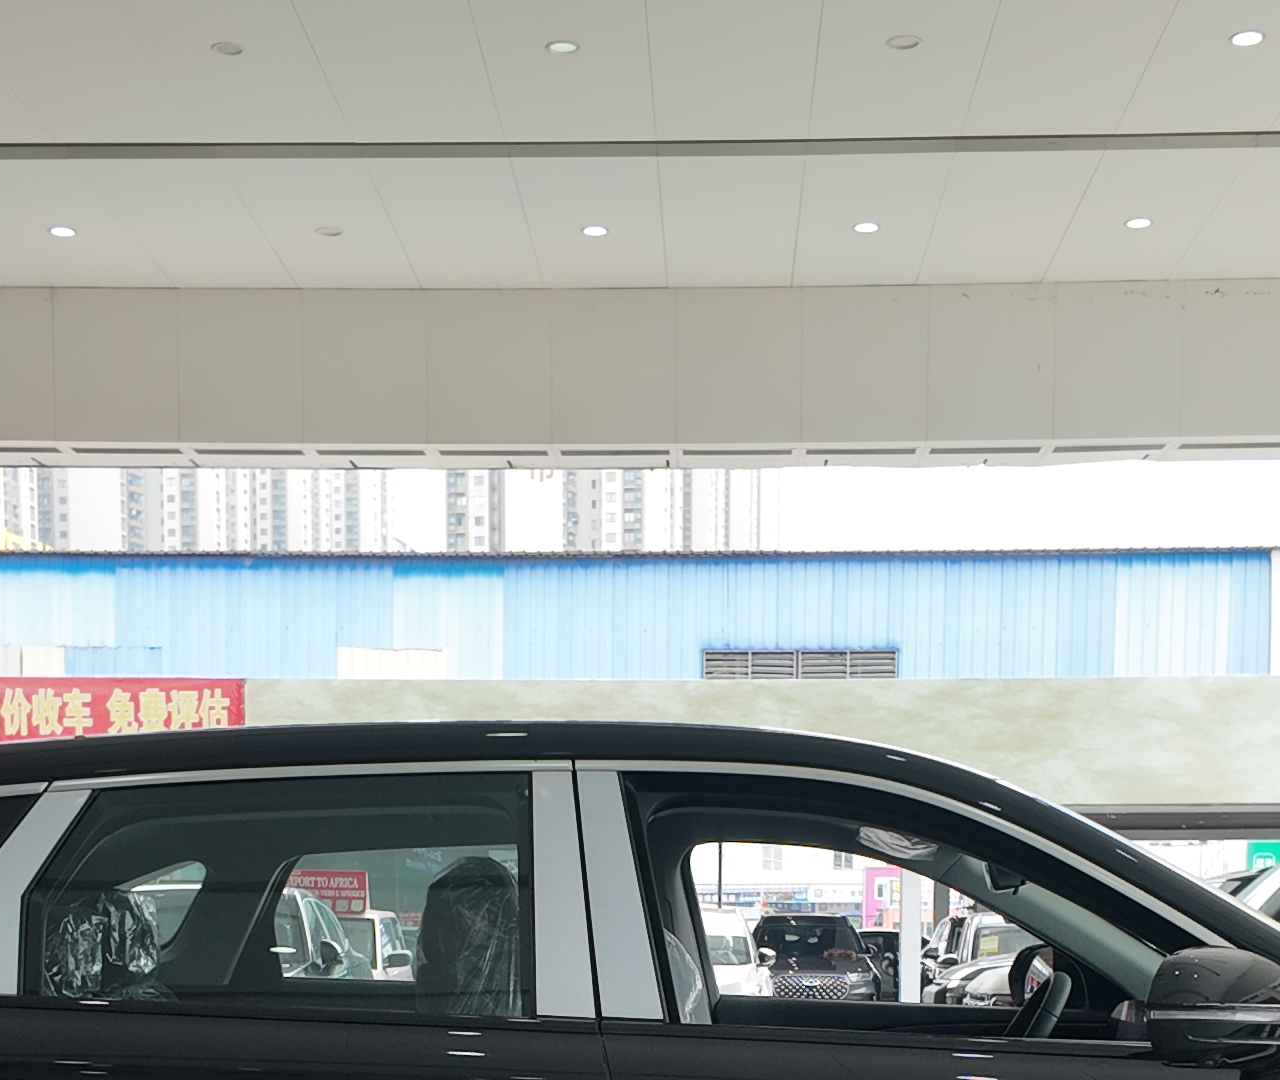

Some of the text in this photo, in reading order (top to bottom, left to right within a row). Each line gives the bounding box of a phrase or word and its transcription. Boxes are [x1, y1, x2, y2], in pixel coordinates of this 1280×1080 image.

[106, 687, 231, 733] 免费评估
[316, 877, 329, 888] TO
[329, 877, 359, 888] AFRICA
